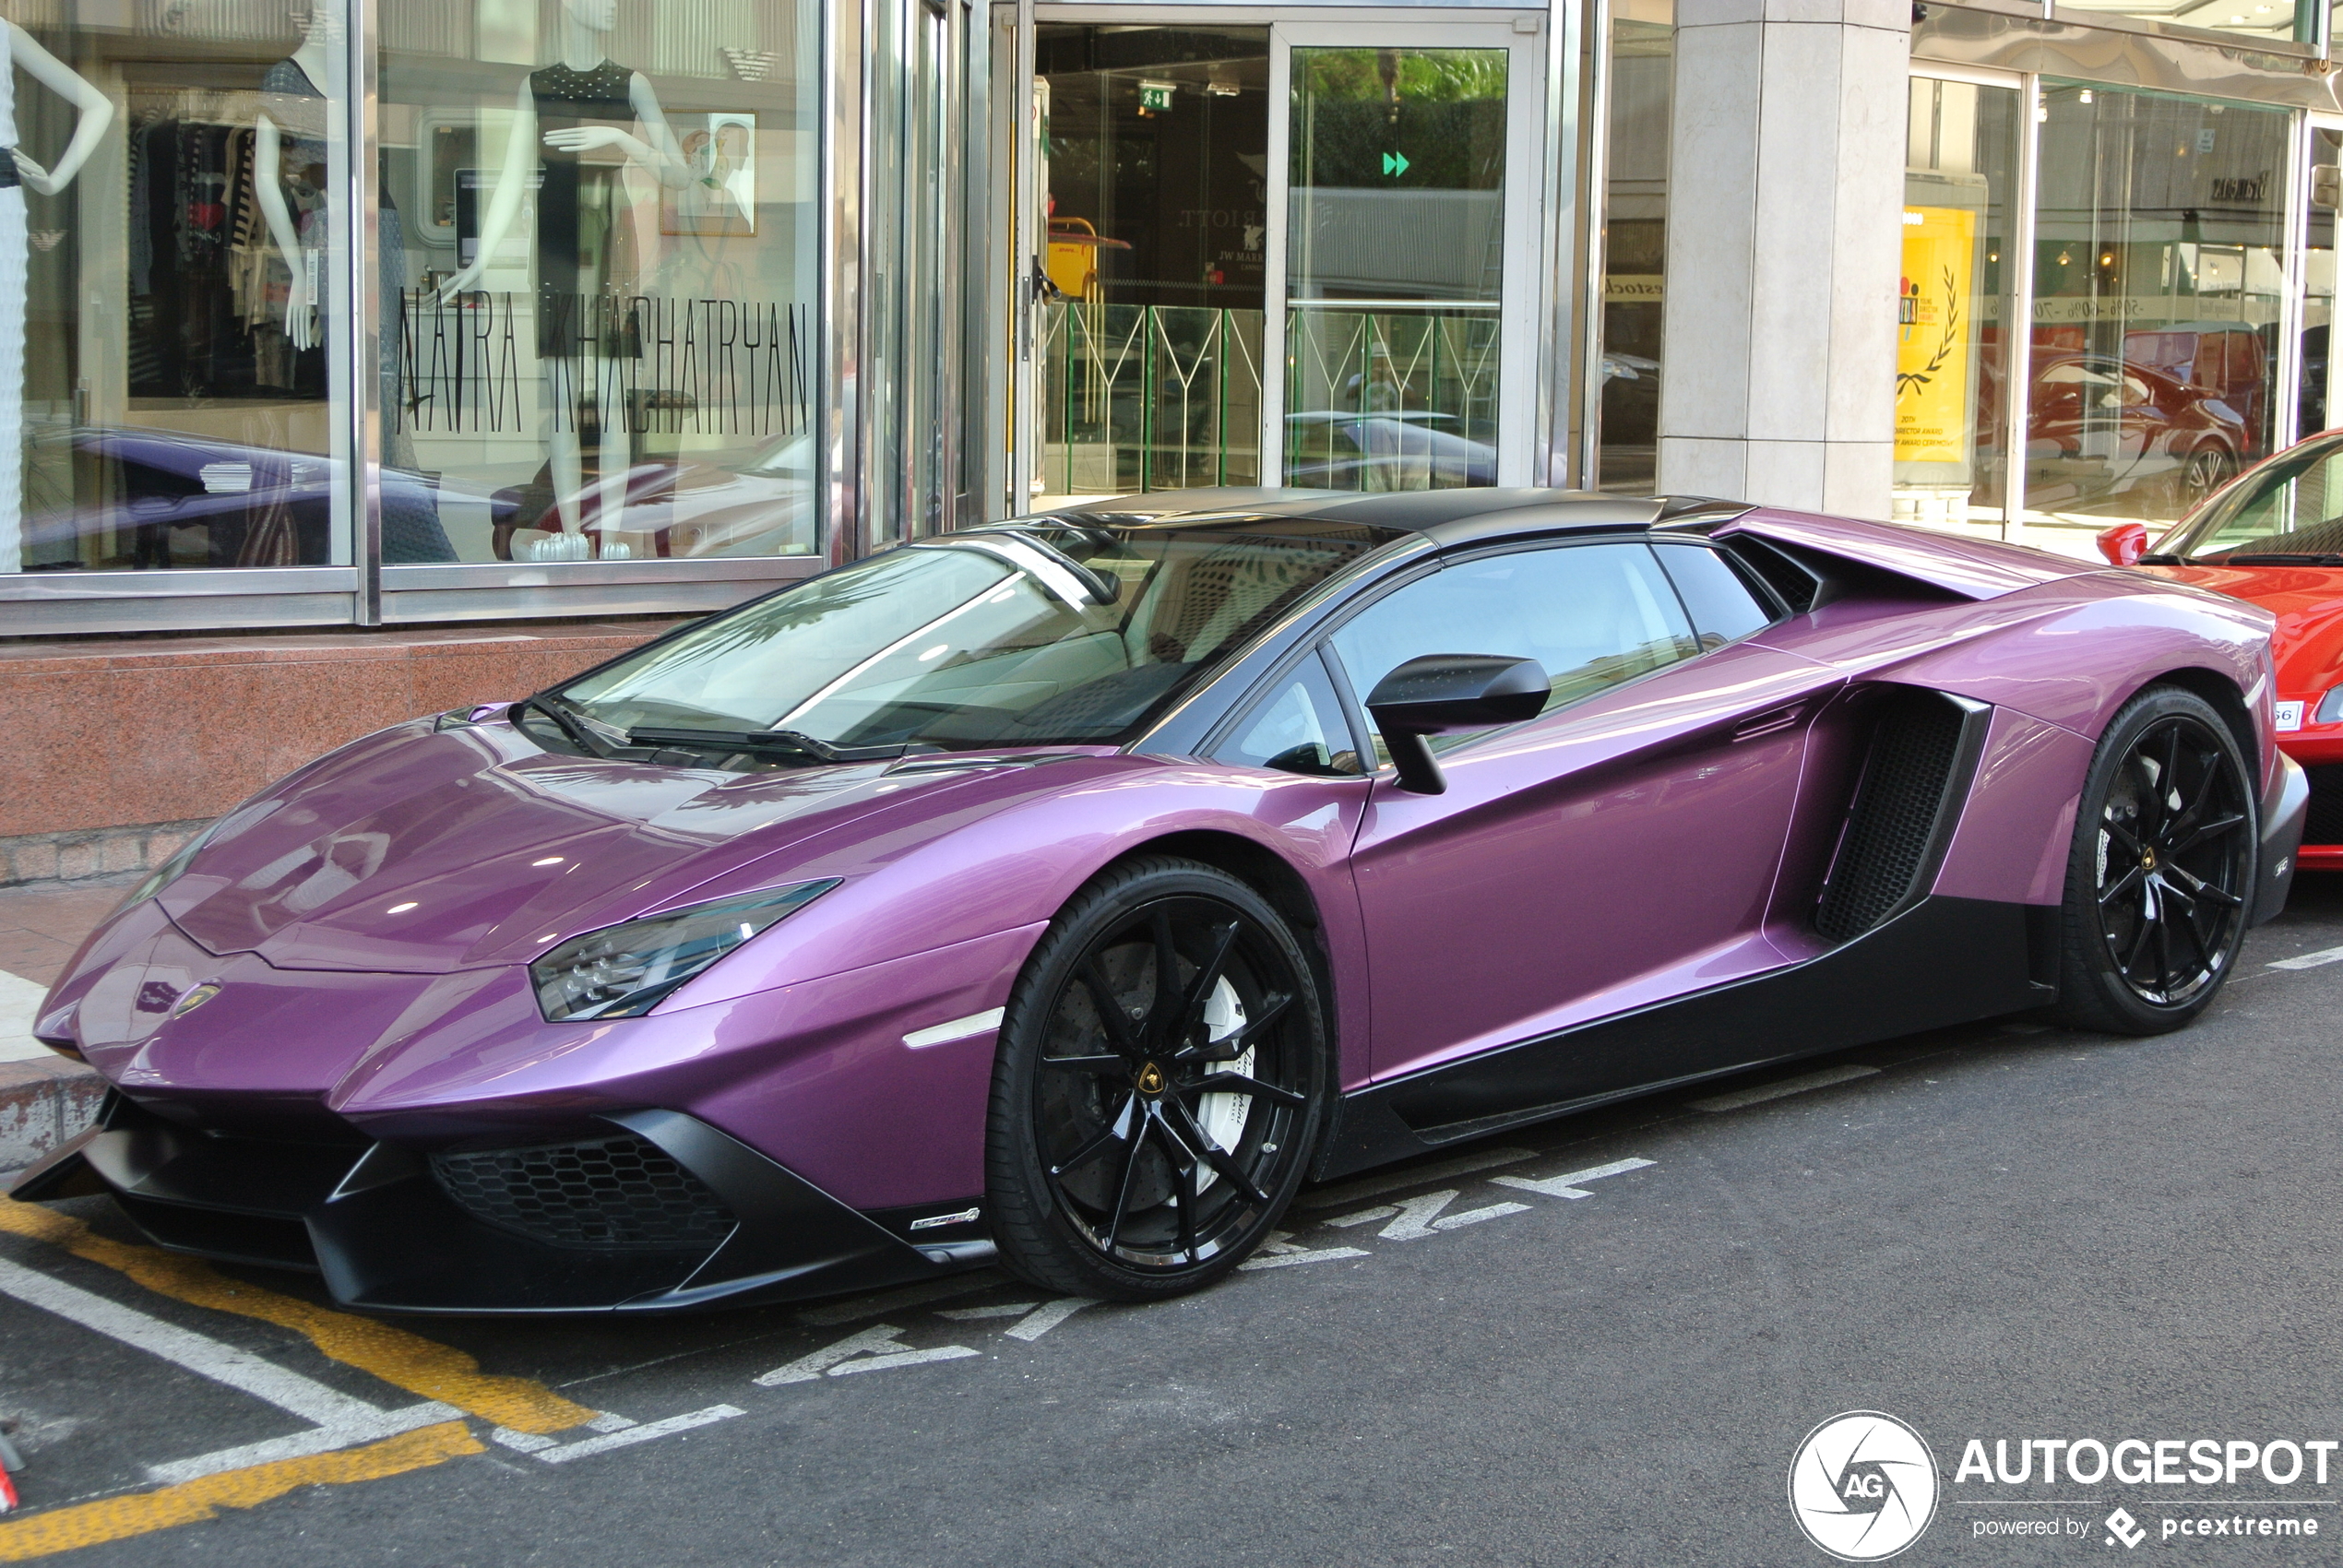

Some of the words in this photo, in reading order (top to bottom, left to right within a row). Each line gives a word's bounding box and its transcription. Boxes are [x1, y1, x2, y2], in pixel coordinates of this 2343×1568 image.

[1219, 251, 1234, 261] JW
[397, 286, 522, 435] NAIRA
[554, 293, 808, 436] KHACHATRYAN
